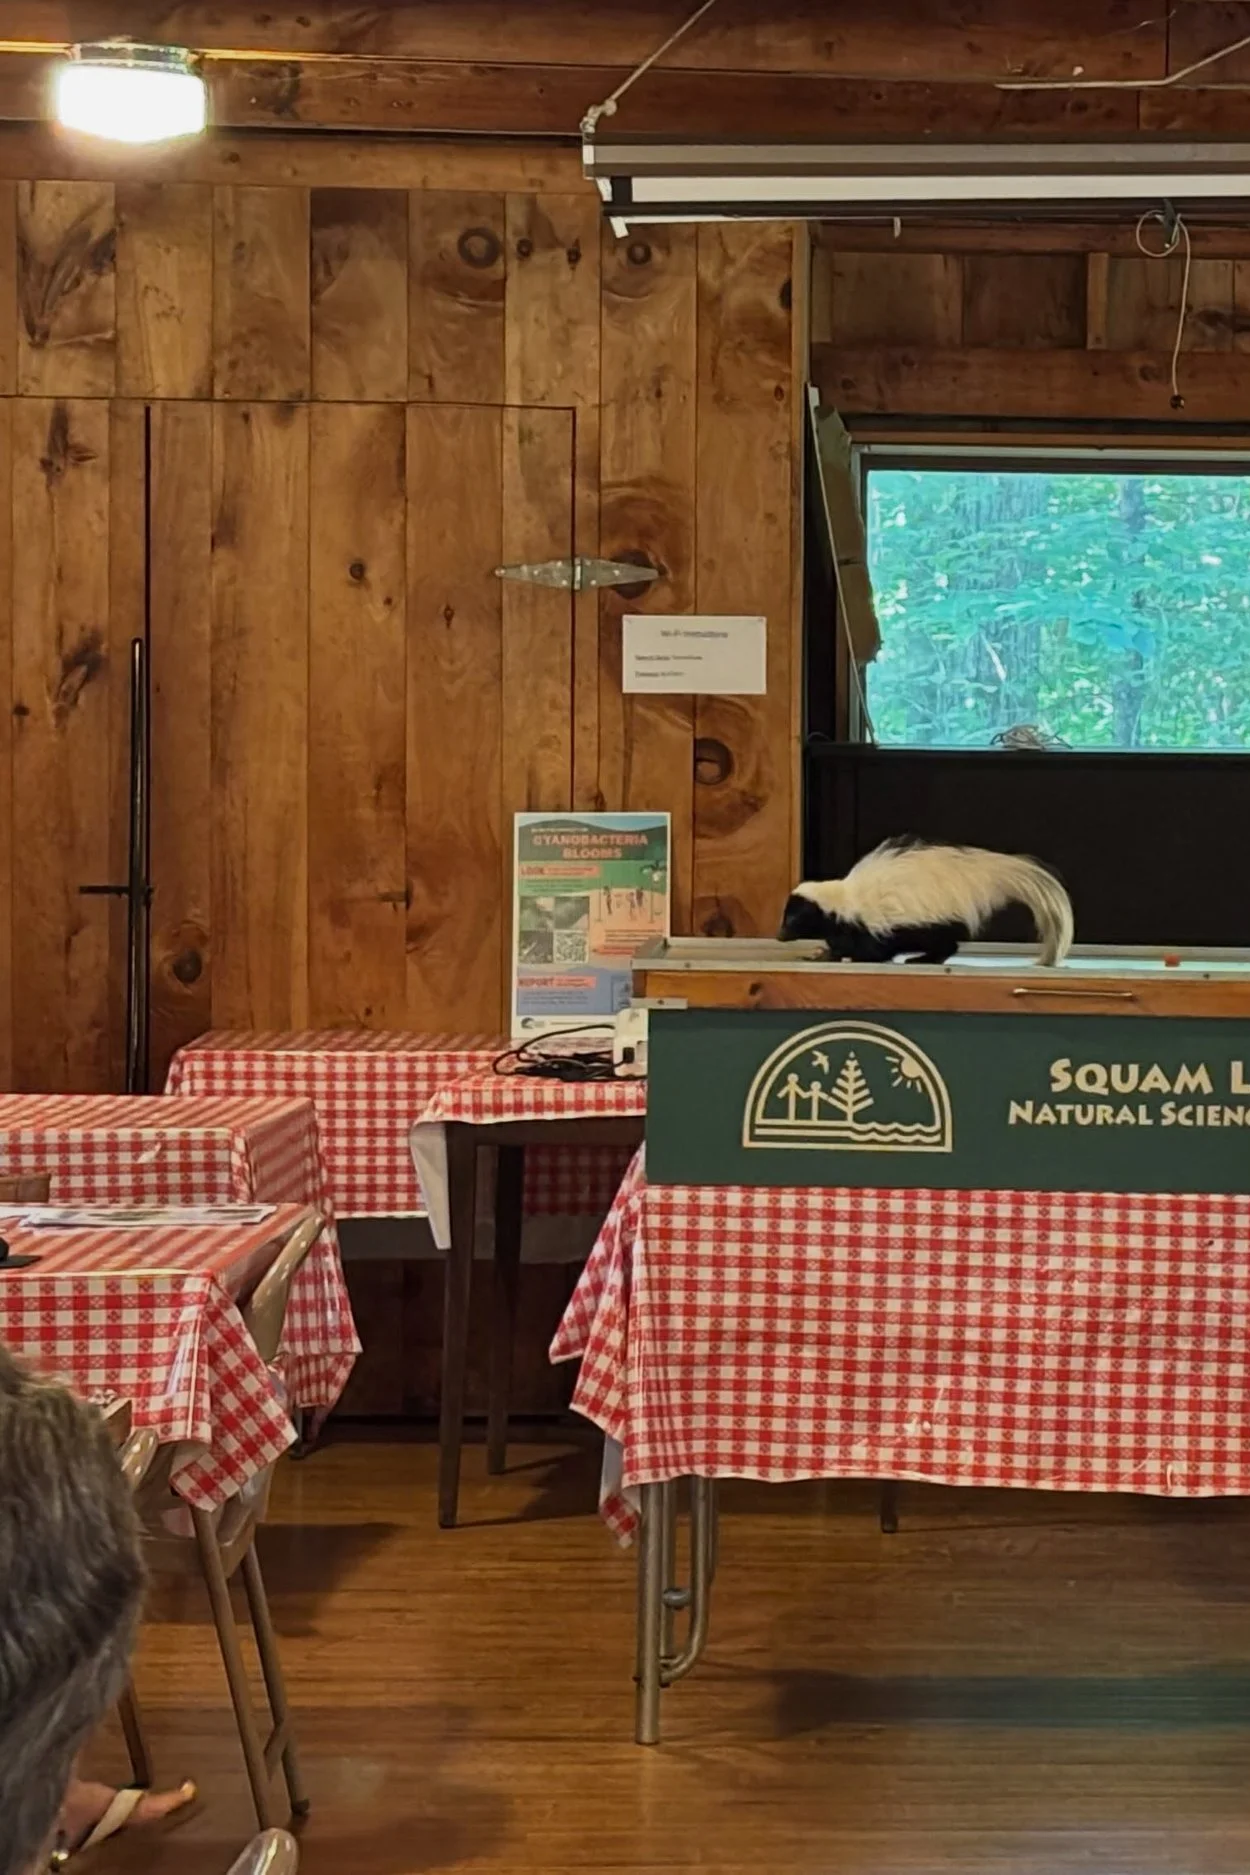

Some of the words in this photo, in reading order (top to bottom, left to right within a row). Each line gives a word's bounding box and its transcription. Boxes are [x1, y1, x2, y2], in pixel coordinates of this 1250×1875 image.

[532, 833, 649, 846] CYANOBACTERIA
[562, 847, 622, 859] BLOOMS
[1050, 1058, 1213, 1096] SQUAM
[1008, 1100, 1153, 1126] NATURAL
